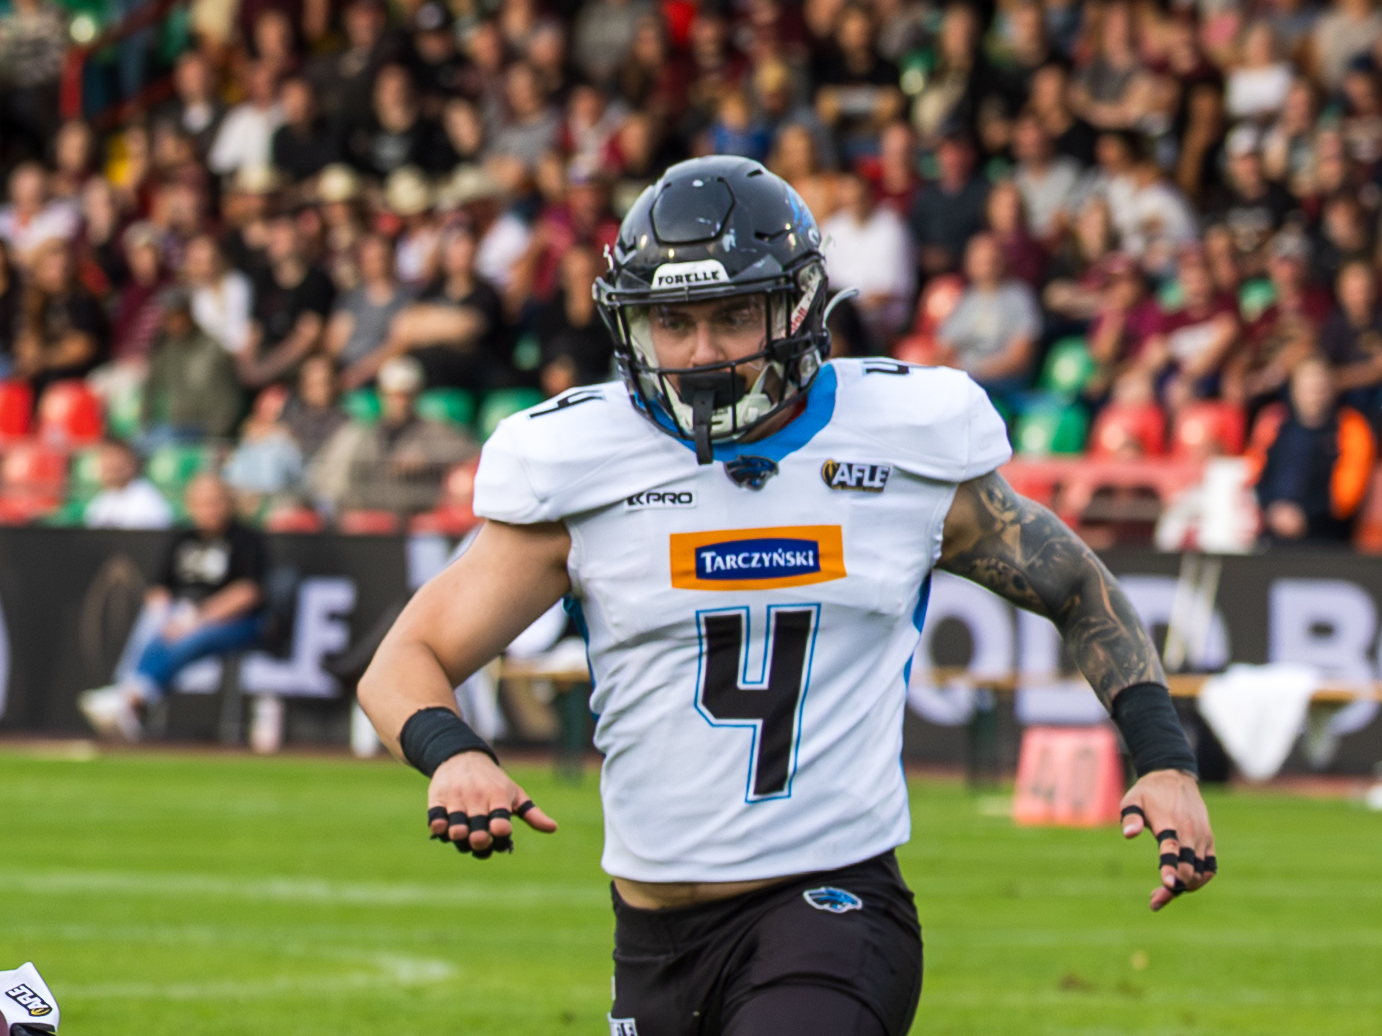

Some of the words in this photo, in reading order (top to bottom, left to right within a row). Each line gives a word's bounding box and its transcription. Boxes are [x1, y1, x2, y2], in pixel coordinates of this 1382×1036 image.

[659, 270, 719, 285] FORELLE
[831, 462, 891, 488] AFLE
[701, 548, 815, 574] TARCZYŃSKI
[694, 603, 821, 803] 4
